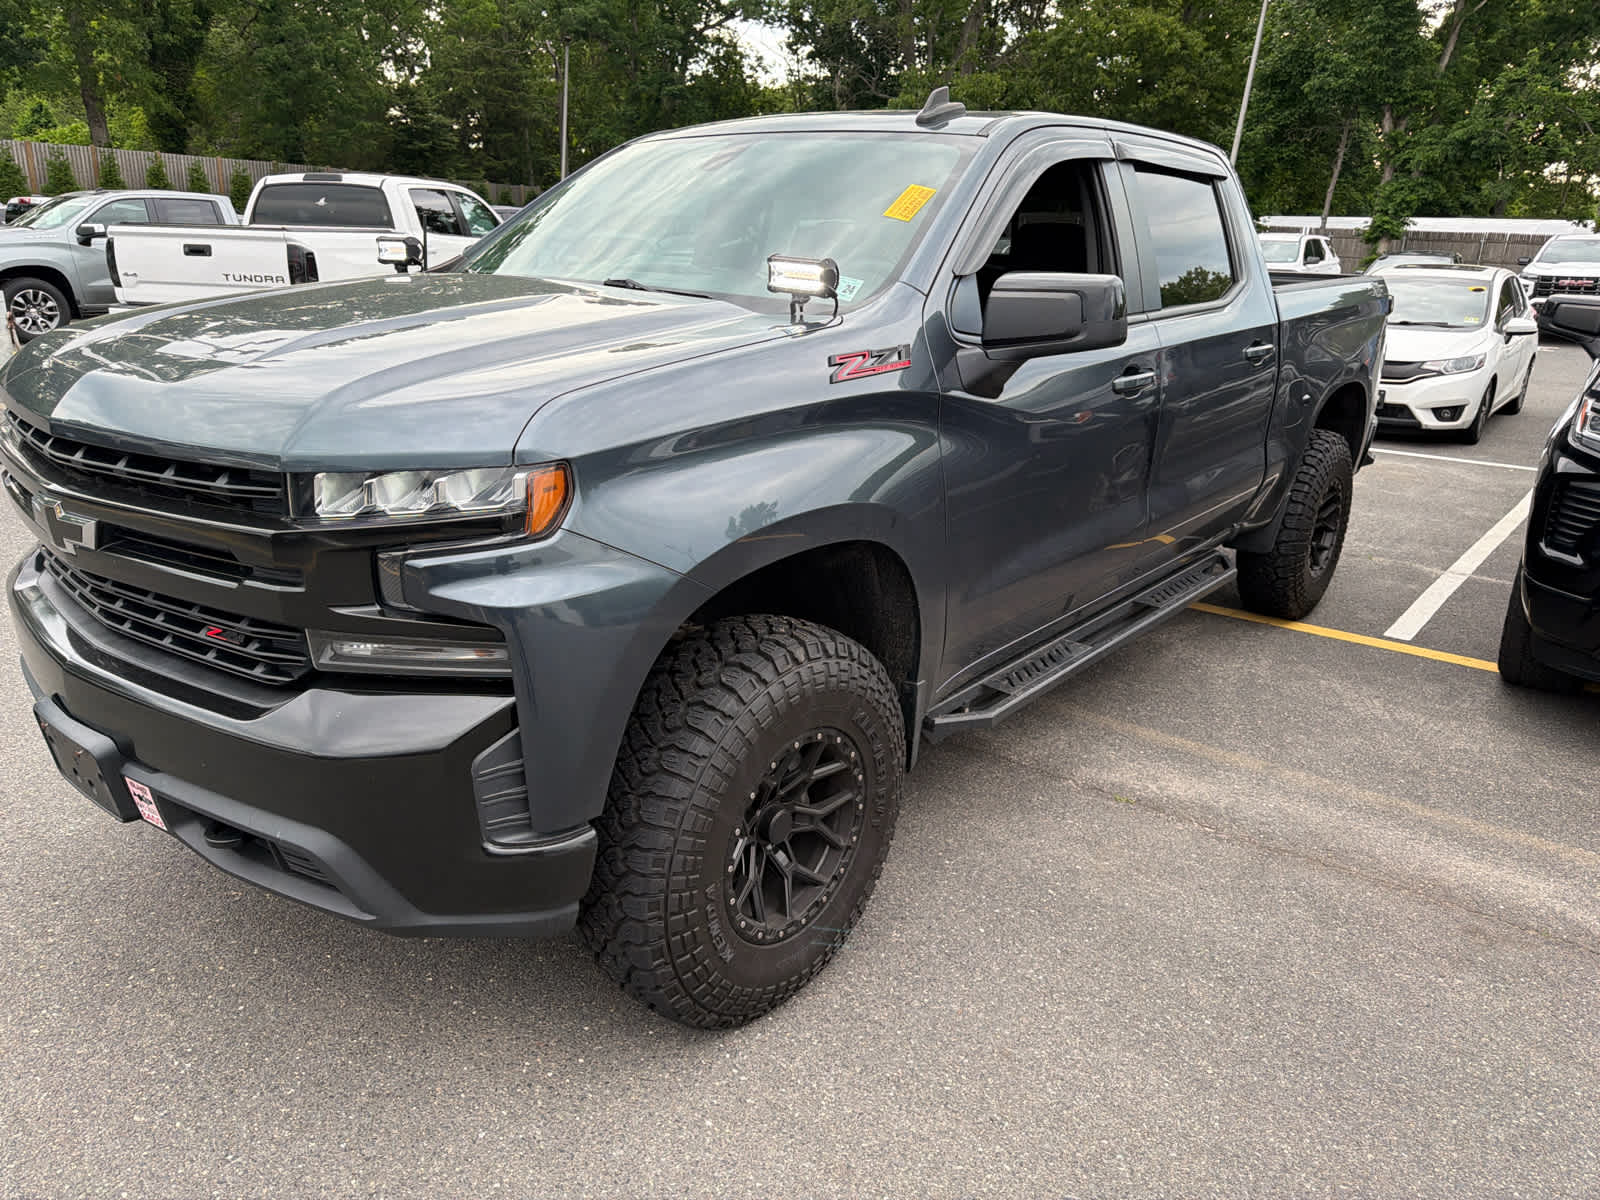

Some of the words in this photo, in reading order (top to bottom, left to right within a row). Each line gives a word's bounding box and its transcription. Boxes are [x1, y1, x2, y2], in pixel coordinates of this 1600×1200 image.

[222, 272, 286, 284] TUNDRA
[828, 344, 912, 384] Z71
[705, 882, 736, 962] KENDA
